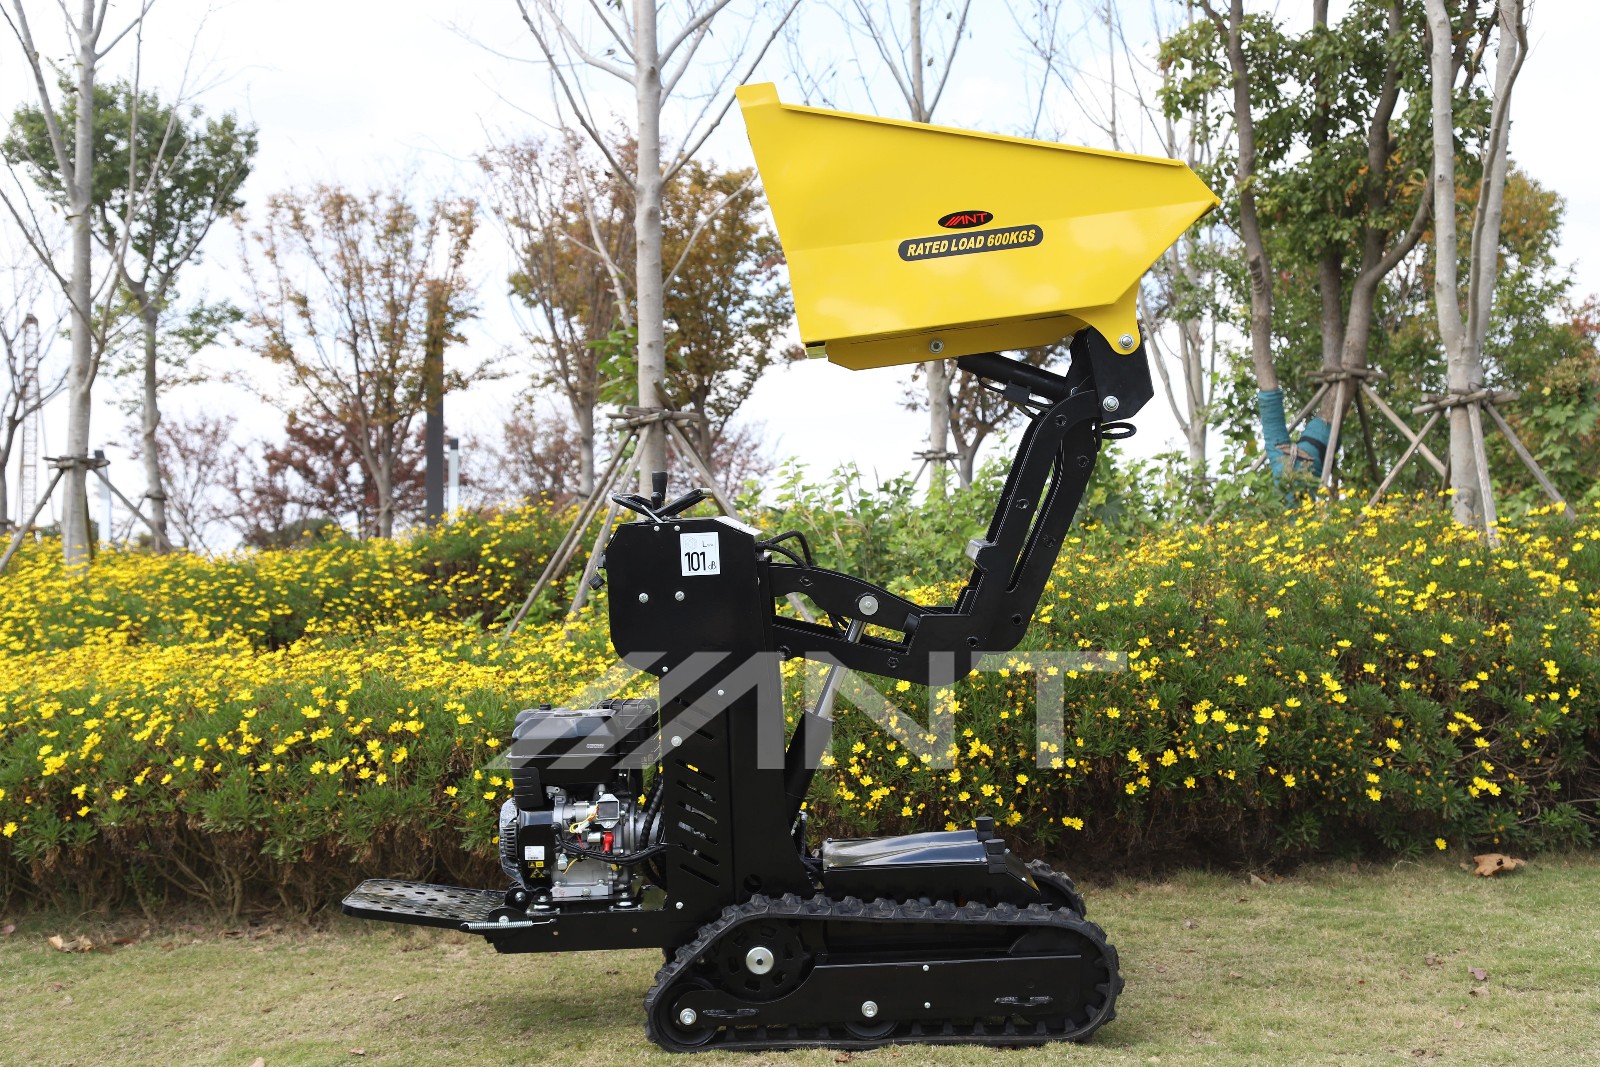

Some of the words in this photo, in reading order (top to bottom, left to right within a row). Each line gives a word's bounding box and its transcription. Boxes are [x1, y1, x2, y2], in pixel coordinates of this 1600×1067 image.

[906, 240, 949, 257] RATED
[950, 235, 985, 252] LOAD
[986, 229, 1036, 247] 600KGS
[684, 551, 706, 572] 101
